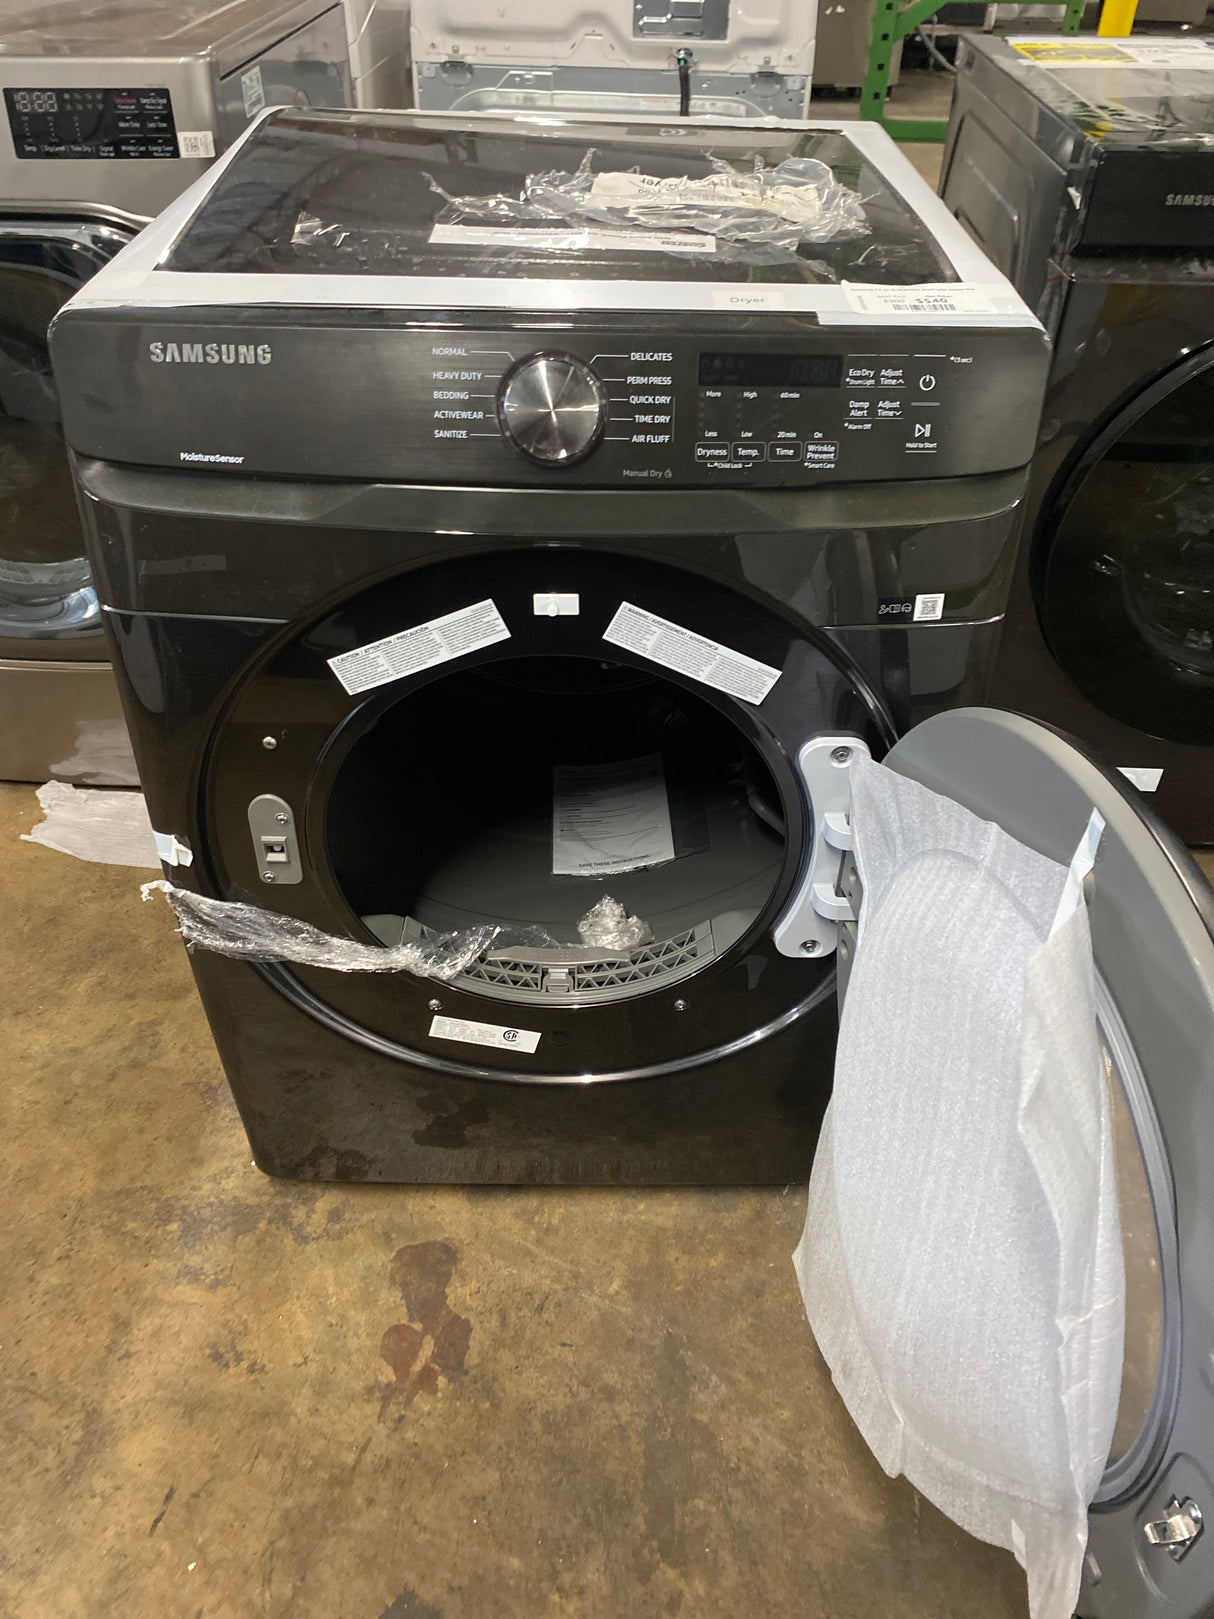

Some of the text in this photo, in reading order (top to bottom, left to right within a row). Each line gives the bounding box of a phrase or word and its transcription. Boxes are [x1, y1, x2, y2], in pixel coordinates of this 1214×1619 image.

[730, 296, 766, 304] Dryer
[150, 342, 272, 364] SAMSUNG
[432, 347, 467, 356] NORMAL
[630, 352, 673, 361] DELICATES
[432, 371, 482, 380] HEAVY DUTY
[848, 369, 875, 378] Eco Dry
[880, 369, 903, 377] Adjust
[627, 376, 672, 385] PERM PRESS
[880, 377, 897, 385] Time
[433, 391, 469, 400] BEDDING
[706, 390, 721, 398] More
[743, 391, 758, 399] High
[629, 395, 671, 404] QUICK DRY
[849, 401, 869, 409] Damp
[877, 401, 900, 409] Adjust
[433, 410, 484, 419] ACTIVEWEAR
[849, 409, 868, 417] Alert
[877, 409, 894, 417] Time
[634, 415, 671, 424] TIME DRY
[433, 429, 468, 438] SANITIZE
[741, 430, 752, 438] Low
[631, 434, 670, 443] AIR FLUFF
[697, 447, 728, 457] Dryness
[737, 447, 760, 457] Temp.
[776, 447, 794, 456] Time
[807, 444, 836, 452] Wrinkle
[180, 452, 245, 464] MoistureSensor
[806, 452, 835, 460] Prevent
[623, 469, 663, 478] Manual Dry
[627, 607, 649, 621] WARNING
[336, 652, 360, 664] CAUTION
[364, 639, 393, 654] ATTENTION
